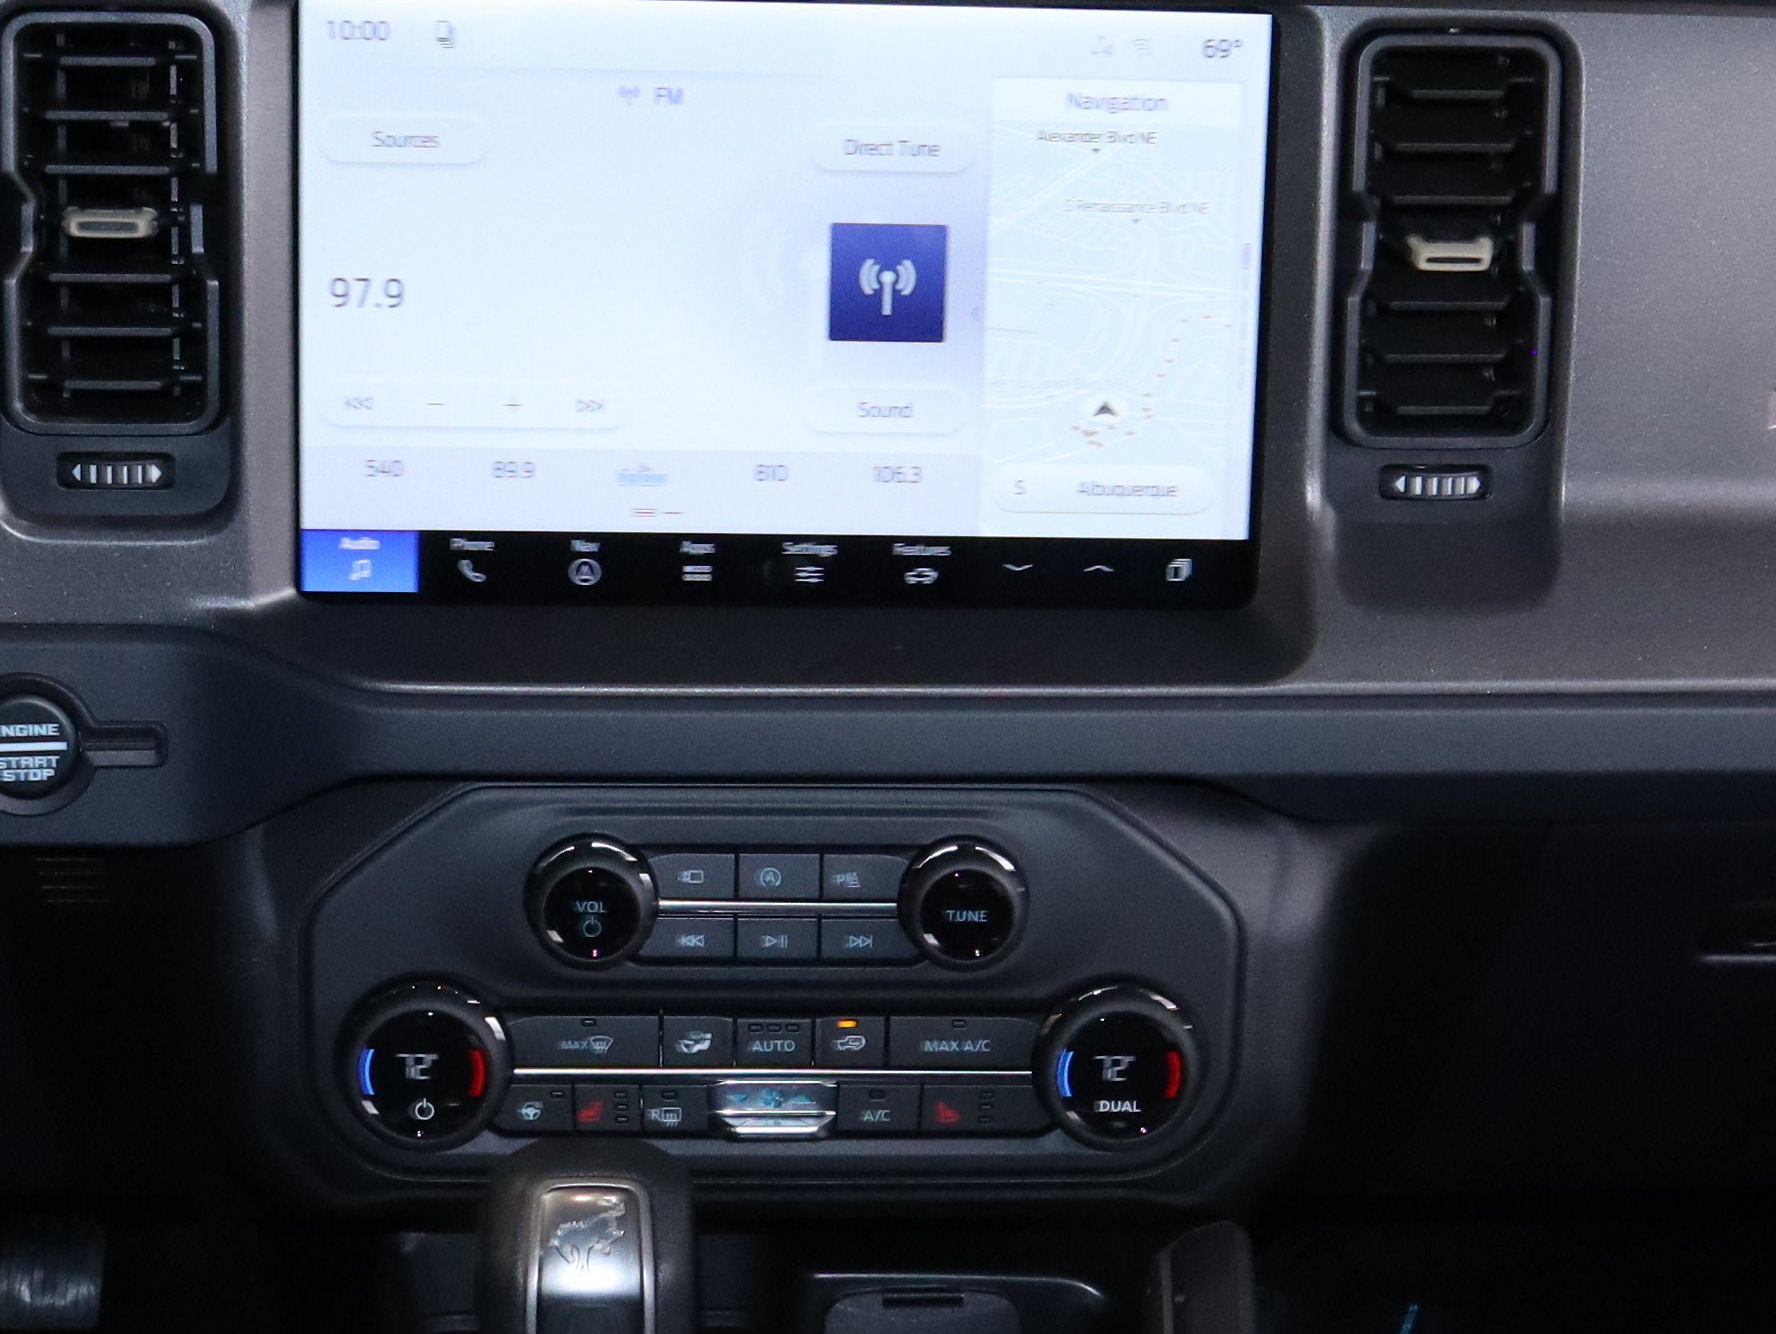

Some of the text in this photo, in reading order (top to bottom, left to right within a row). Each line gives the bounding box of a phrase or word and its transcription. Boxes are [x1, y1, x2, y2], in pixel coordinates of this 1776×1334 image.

[325, 19, 391, 41] 10:00
[653, 87, 685, 105] FM
[1066, 91, 1169, 114] Navigation
[370, 130, 441, 149] Sources
[842, 138, 941, 157] Direct Tune
[329, 276, 405, 310] 97.9
[856, 401, 914, 419] Sound
[362, 459, 405, 478] 540
[1077, 480, 1180, 499] Albuquerque
[449, 537, 496, 552] Phone
[569, 539, 601, 553] Nav
[781, 541, 839, 558] Settings
[891, 543, 952, 557] Features
[575, 900, 608, 914] VOL
[945, 909, 988, 923] TUNE
[560, 1039, 589, 1051] MAX
[749, 1038, 796, 1053] AUTO
[923, 1038, 992, 1053] MAX A/C
[1095, 1099, 1141, 1113] DUAL
[860, 1108, 892, 1122] A/C
